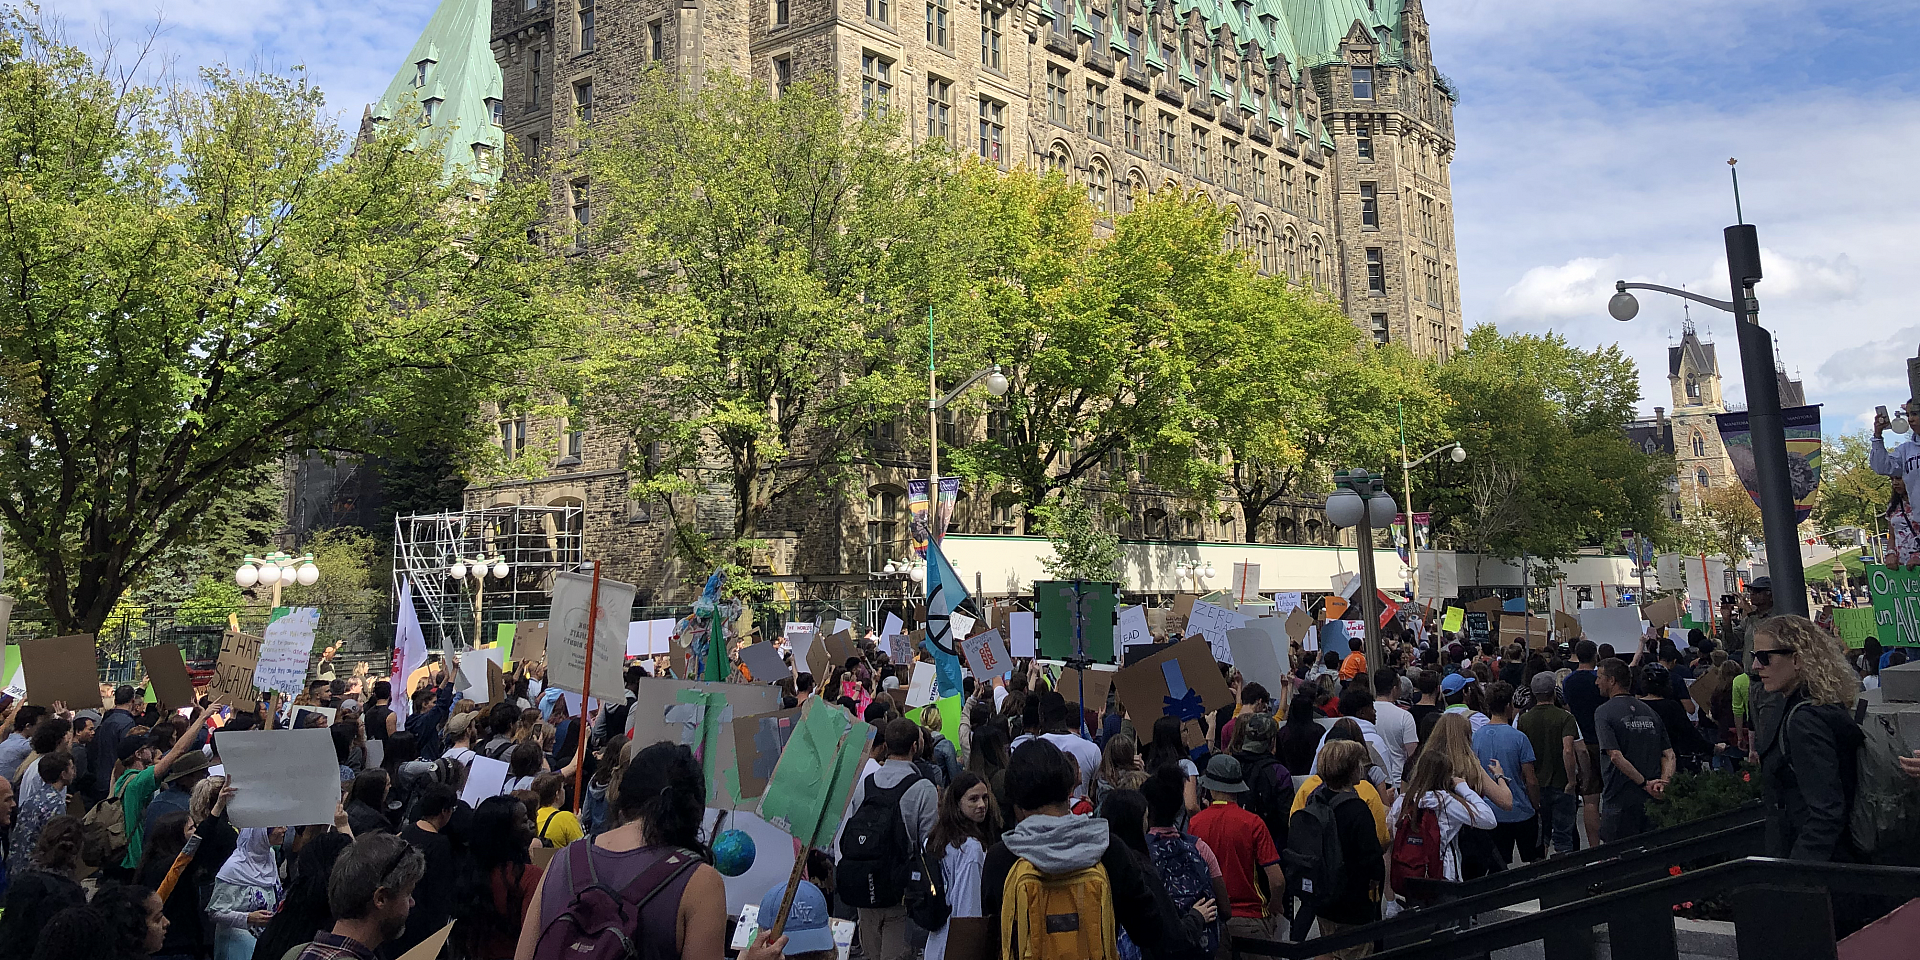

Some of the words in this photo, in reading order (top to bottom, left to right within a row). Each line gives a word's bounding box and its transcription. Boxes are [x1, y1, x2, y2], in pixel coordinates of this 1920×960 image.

[1873, 570, 1898, 595] On
[1901, 578, 1920, 593] ve
[1195, 602, 1234, 624] ZERO
[1876, 609, 1893, 625] un
[1893, 596, 1920, 643] AVE
[221, 634, 234, 652] I
[235, 637, 262, 660] HAT
[1121, 629, 1140, 643] EAD
[280, 682, 303, 694] BREATH
